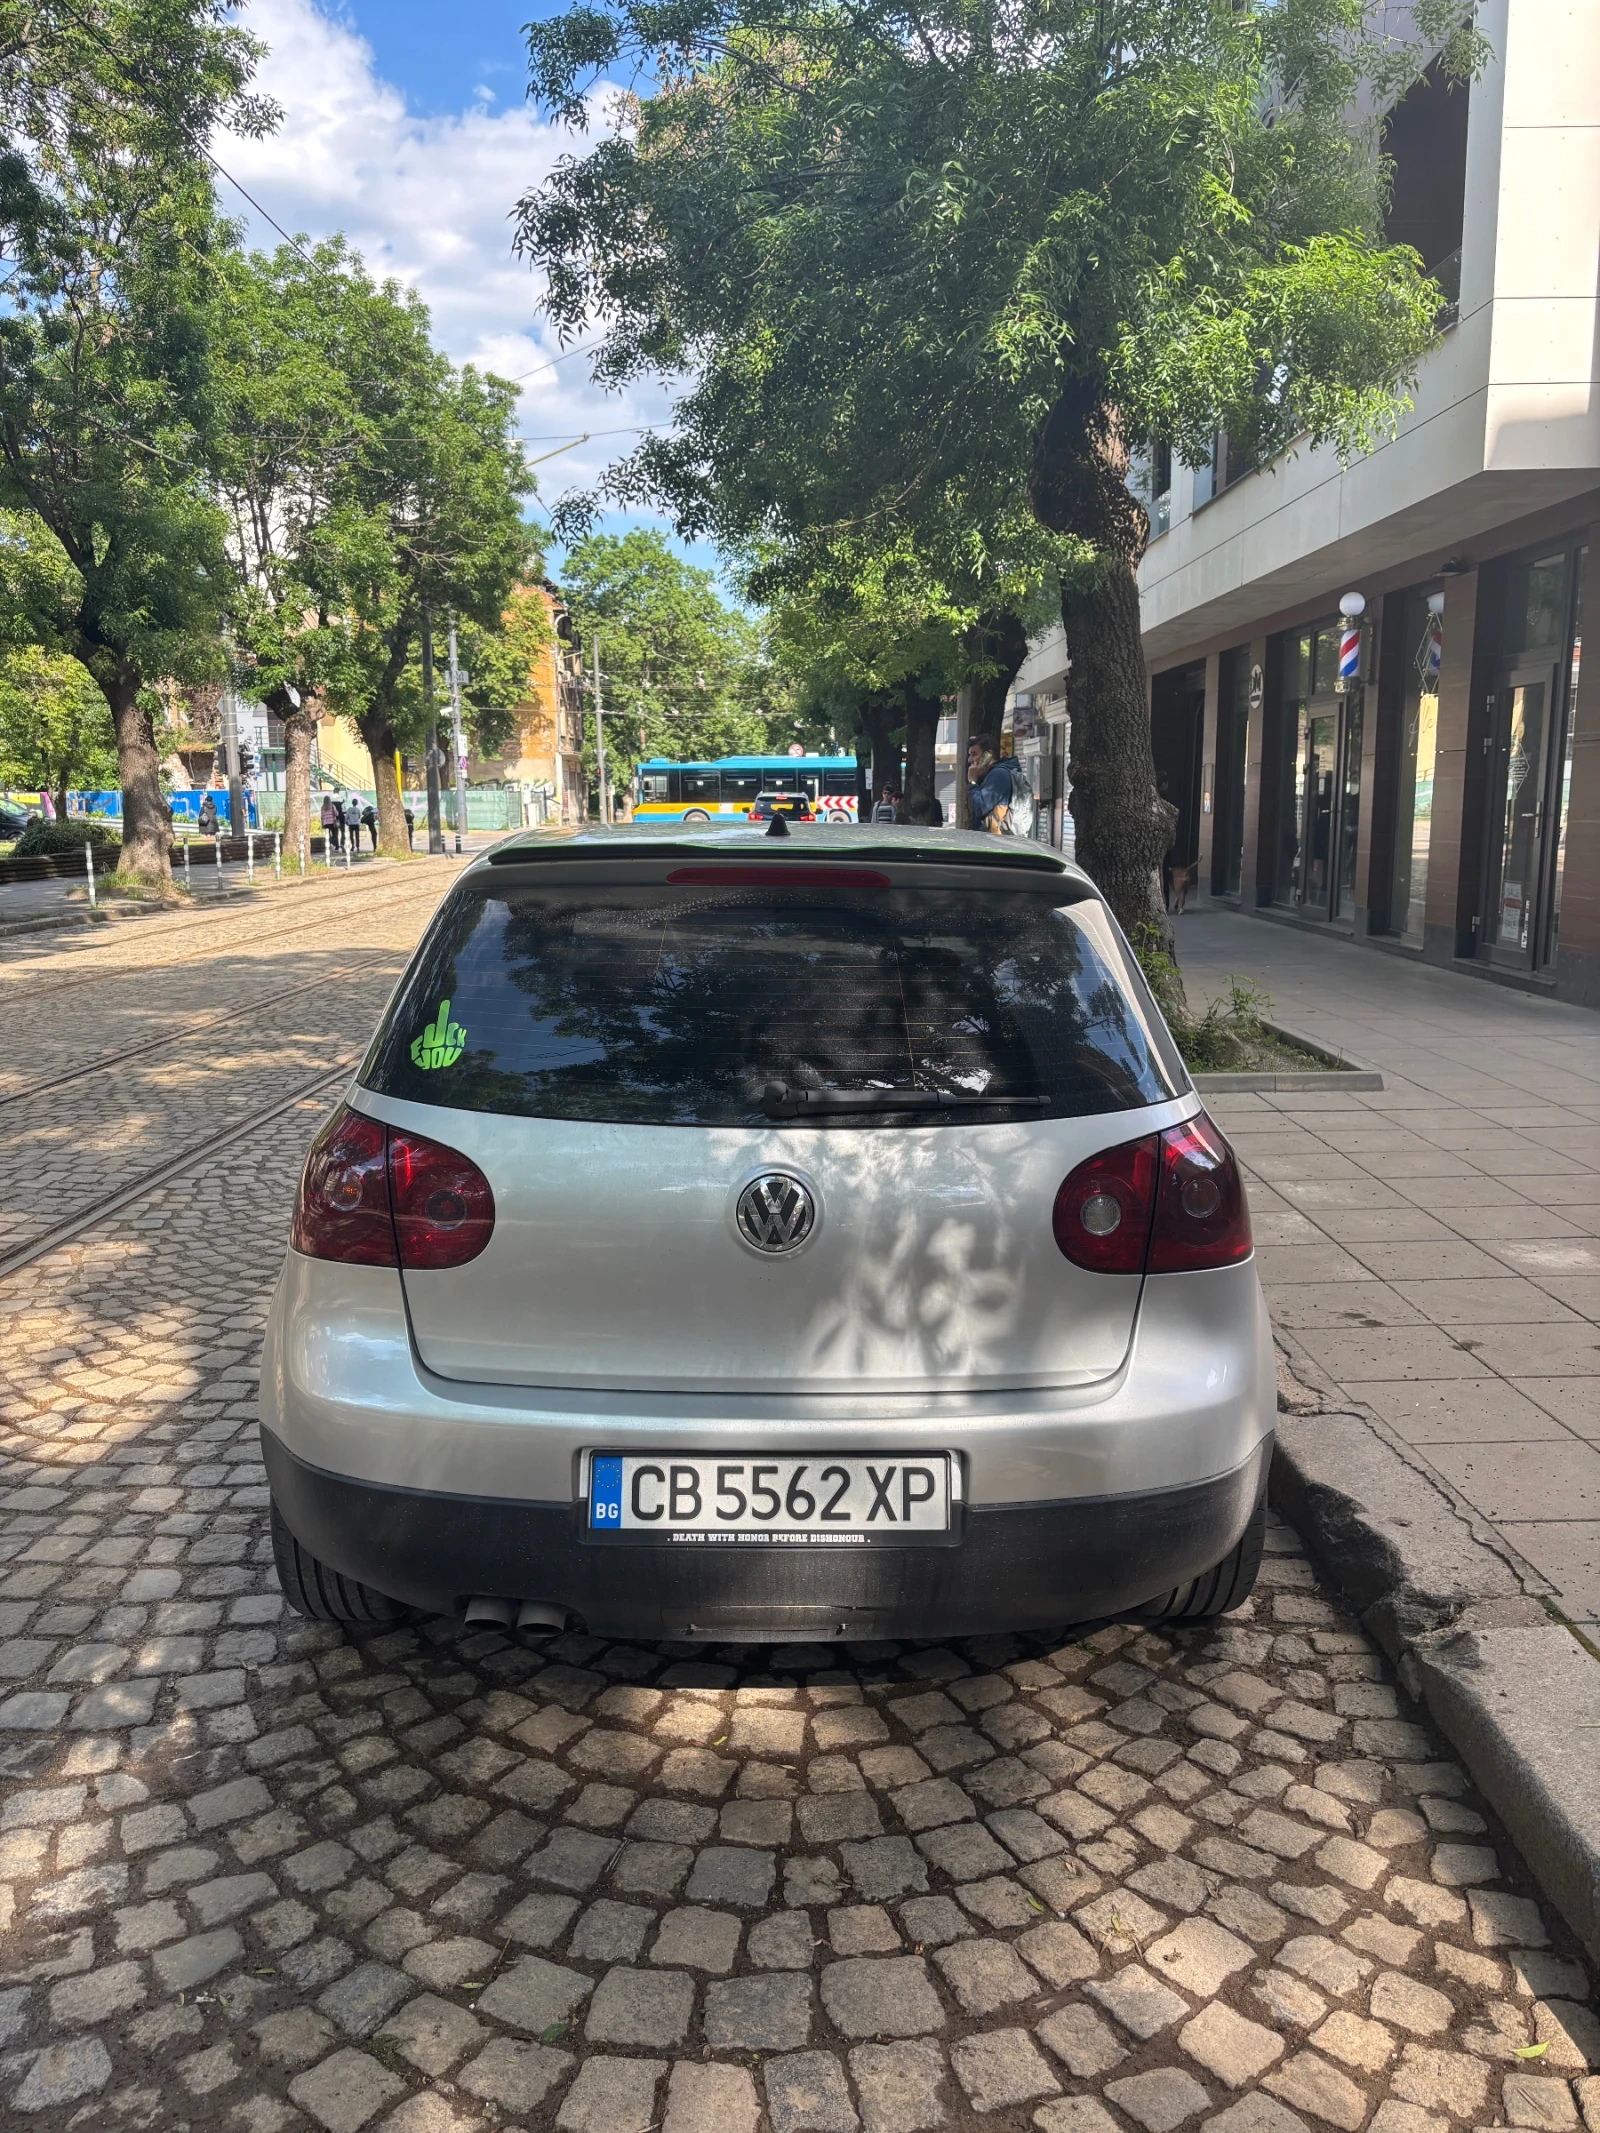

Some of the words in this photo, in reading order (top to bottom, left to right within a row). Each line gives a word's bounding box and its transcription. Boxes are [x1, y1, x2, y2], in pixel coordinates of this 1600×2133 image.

[410, 999, 467, 1061] FUCK
[414, 1047, 463, 1070] YOU
[739, 1175, 811, 1249] VW
[596, 1503, 619, 1519] BG
[631, 1465, 702, 1522] CB
[716, 1465, 852, 1522] 5562
[866, 1466, 935, 1522] XP
[672, 1533, 705, 1542] DEATH
[707, 1533, 736, 1542] WITH
[737, 1533, 770, 1543] HONOR
[810, 1534, 865, 1543] DISHONOUR
